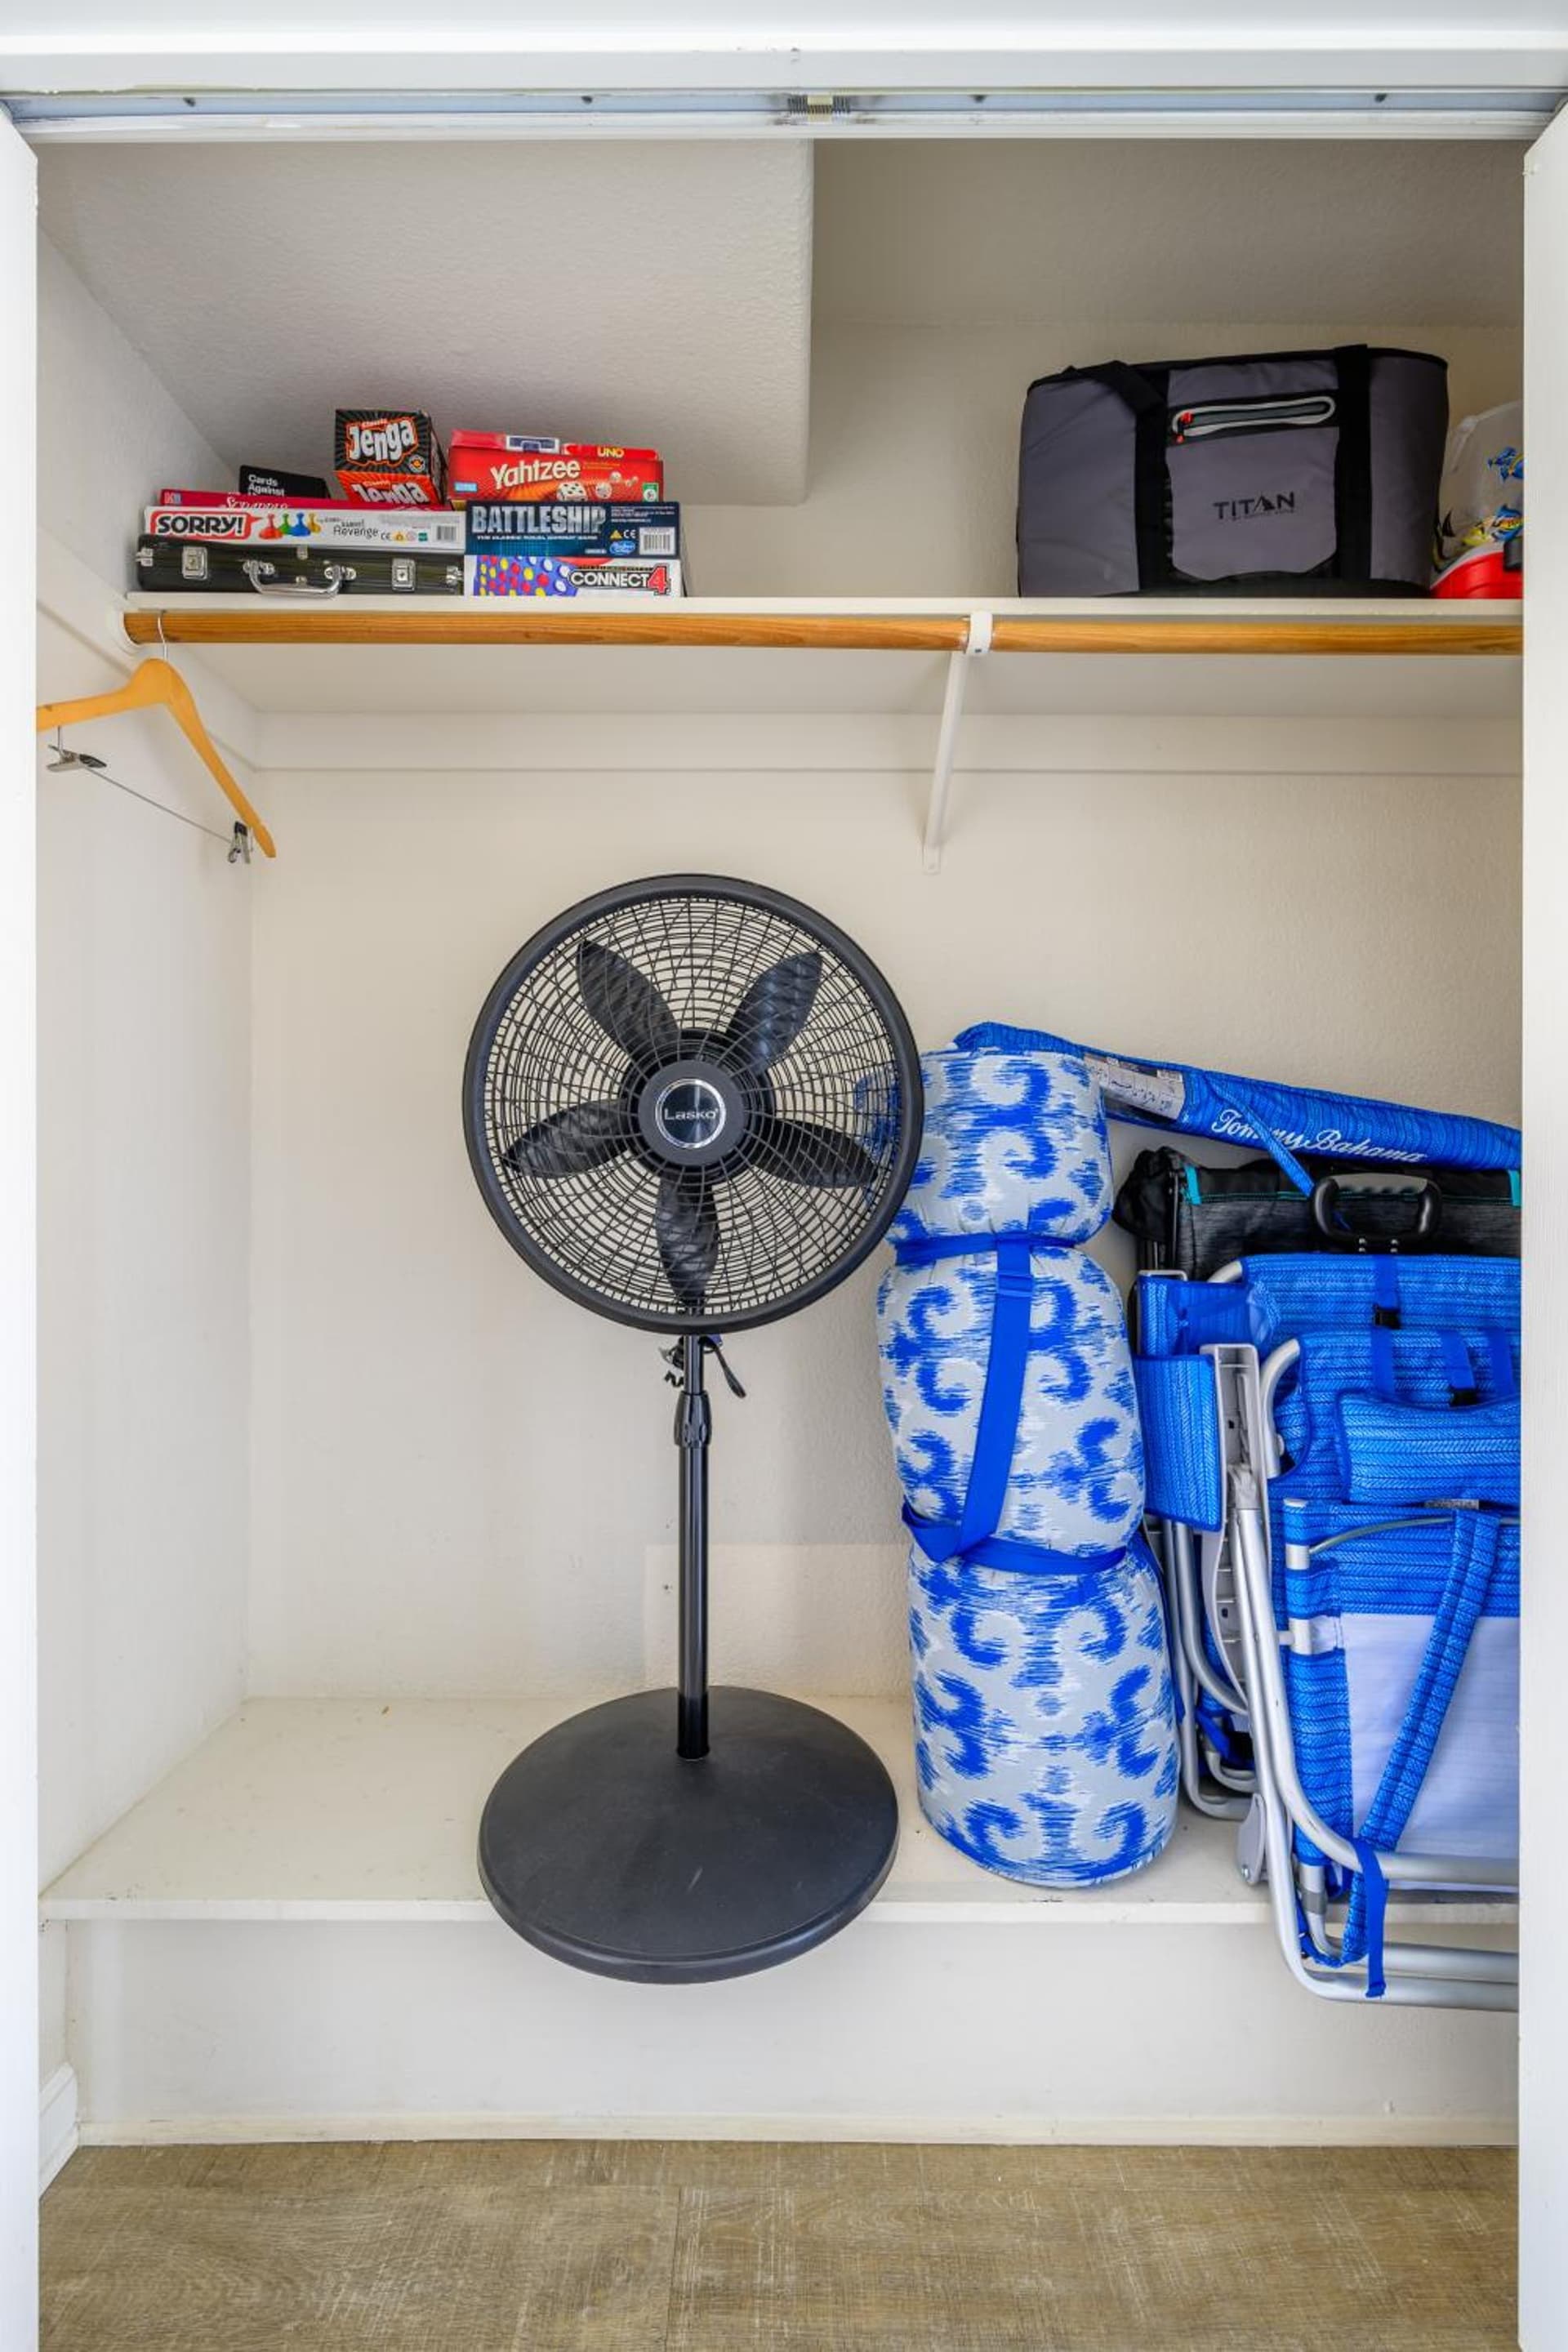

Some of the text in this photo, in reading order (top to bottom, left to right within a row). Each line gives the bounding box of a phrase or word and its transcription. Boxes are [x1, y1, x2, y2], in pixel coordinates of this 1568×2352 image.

[349, 420, 414, 461] Jenga
[597, 446, 625, 457] UNO
[248, 474, 278, 488] Cards
[490, 460, 581, 490] Yahtzee
[247, 482, 284, 497] Against
[471, 506, 606, 533] BATTLESHIP
[1212, 492, 1294, 520] TITAN
[158, 515, 244, 534] SORRY!
[333, 524, 378, 539] Revenge
[571, 566, 668, 595] CONNECT 4
[1306, 1129, 1428, 1163] Bahama
